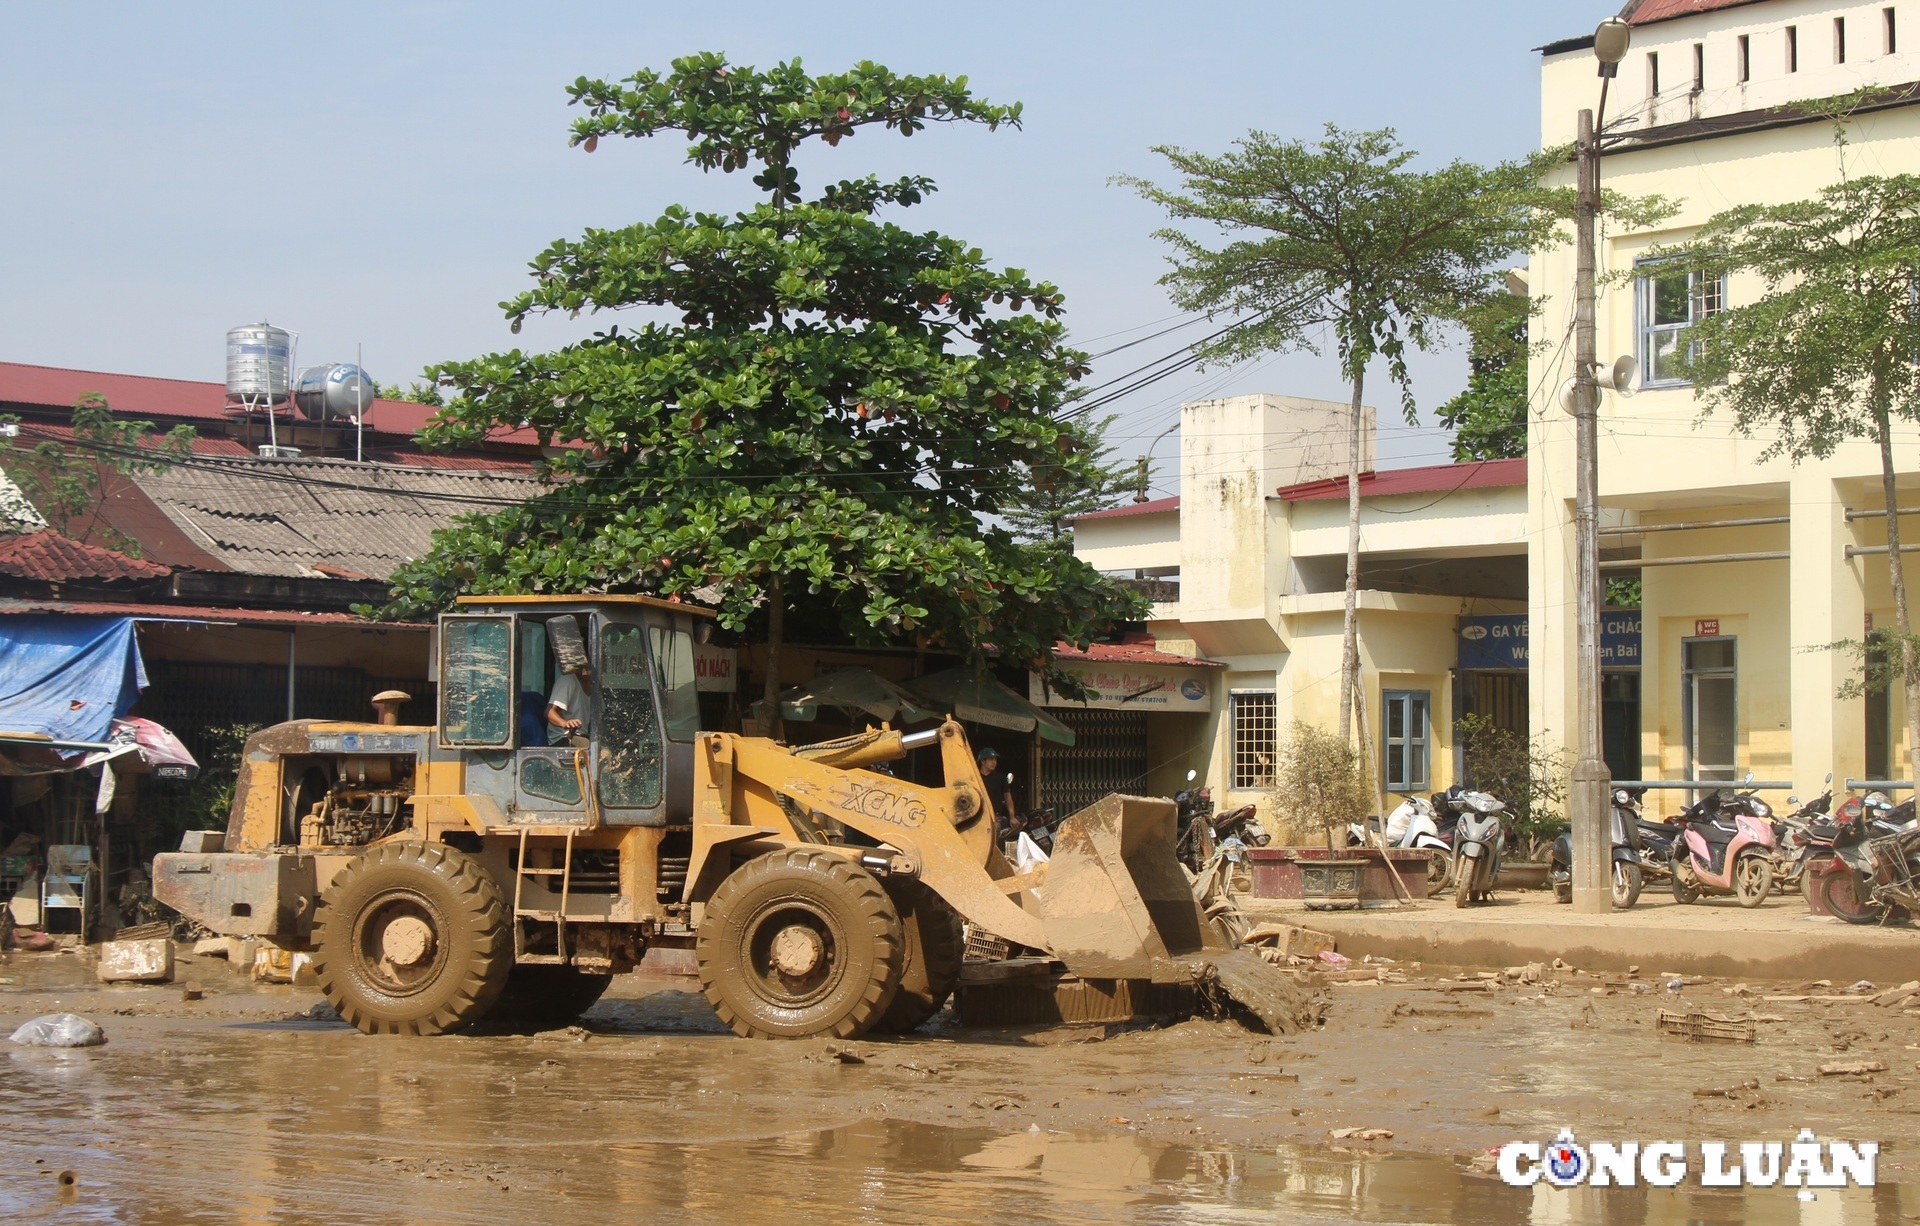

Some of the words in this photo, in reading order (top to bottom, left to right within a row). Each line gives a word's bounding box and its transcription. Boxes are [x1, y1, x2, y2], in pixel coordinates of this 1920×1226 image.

[1491, 625, 1510, 638] GA
[1514, 620, 1529, 637] YÊ
[1600, 647, 1613, 658] en
[1617, 643, 1637, 657] Bai
[840, 782, 927, 828] XCMG
